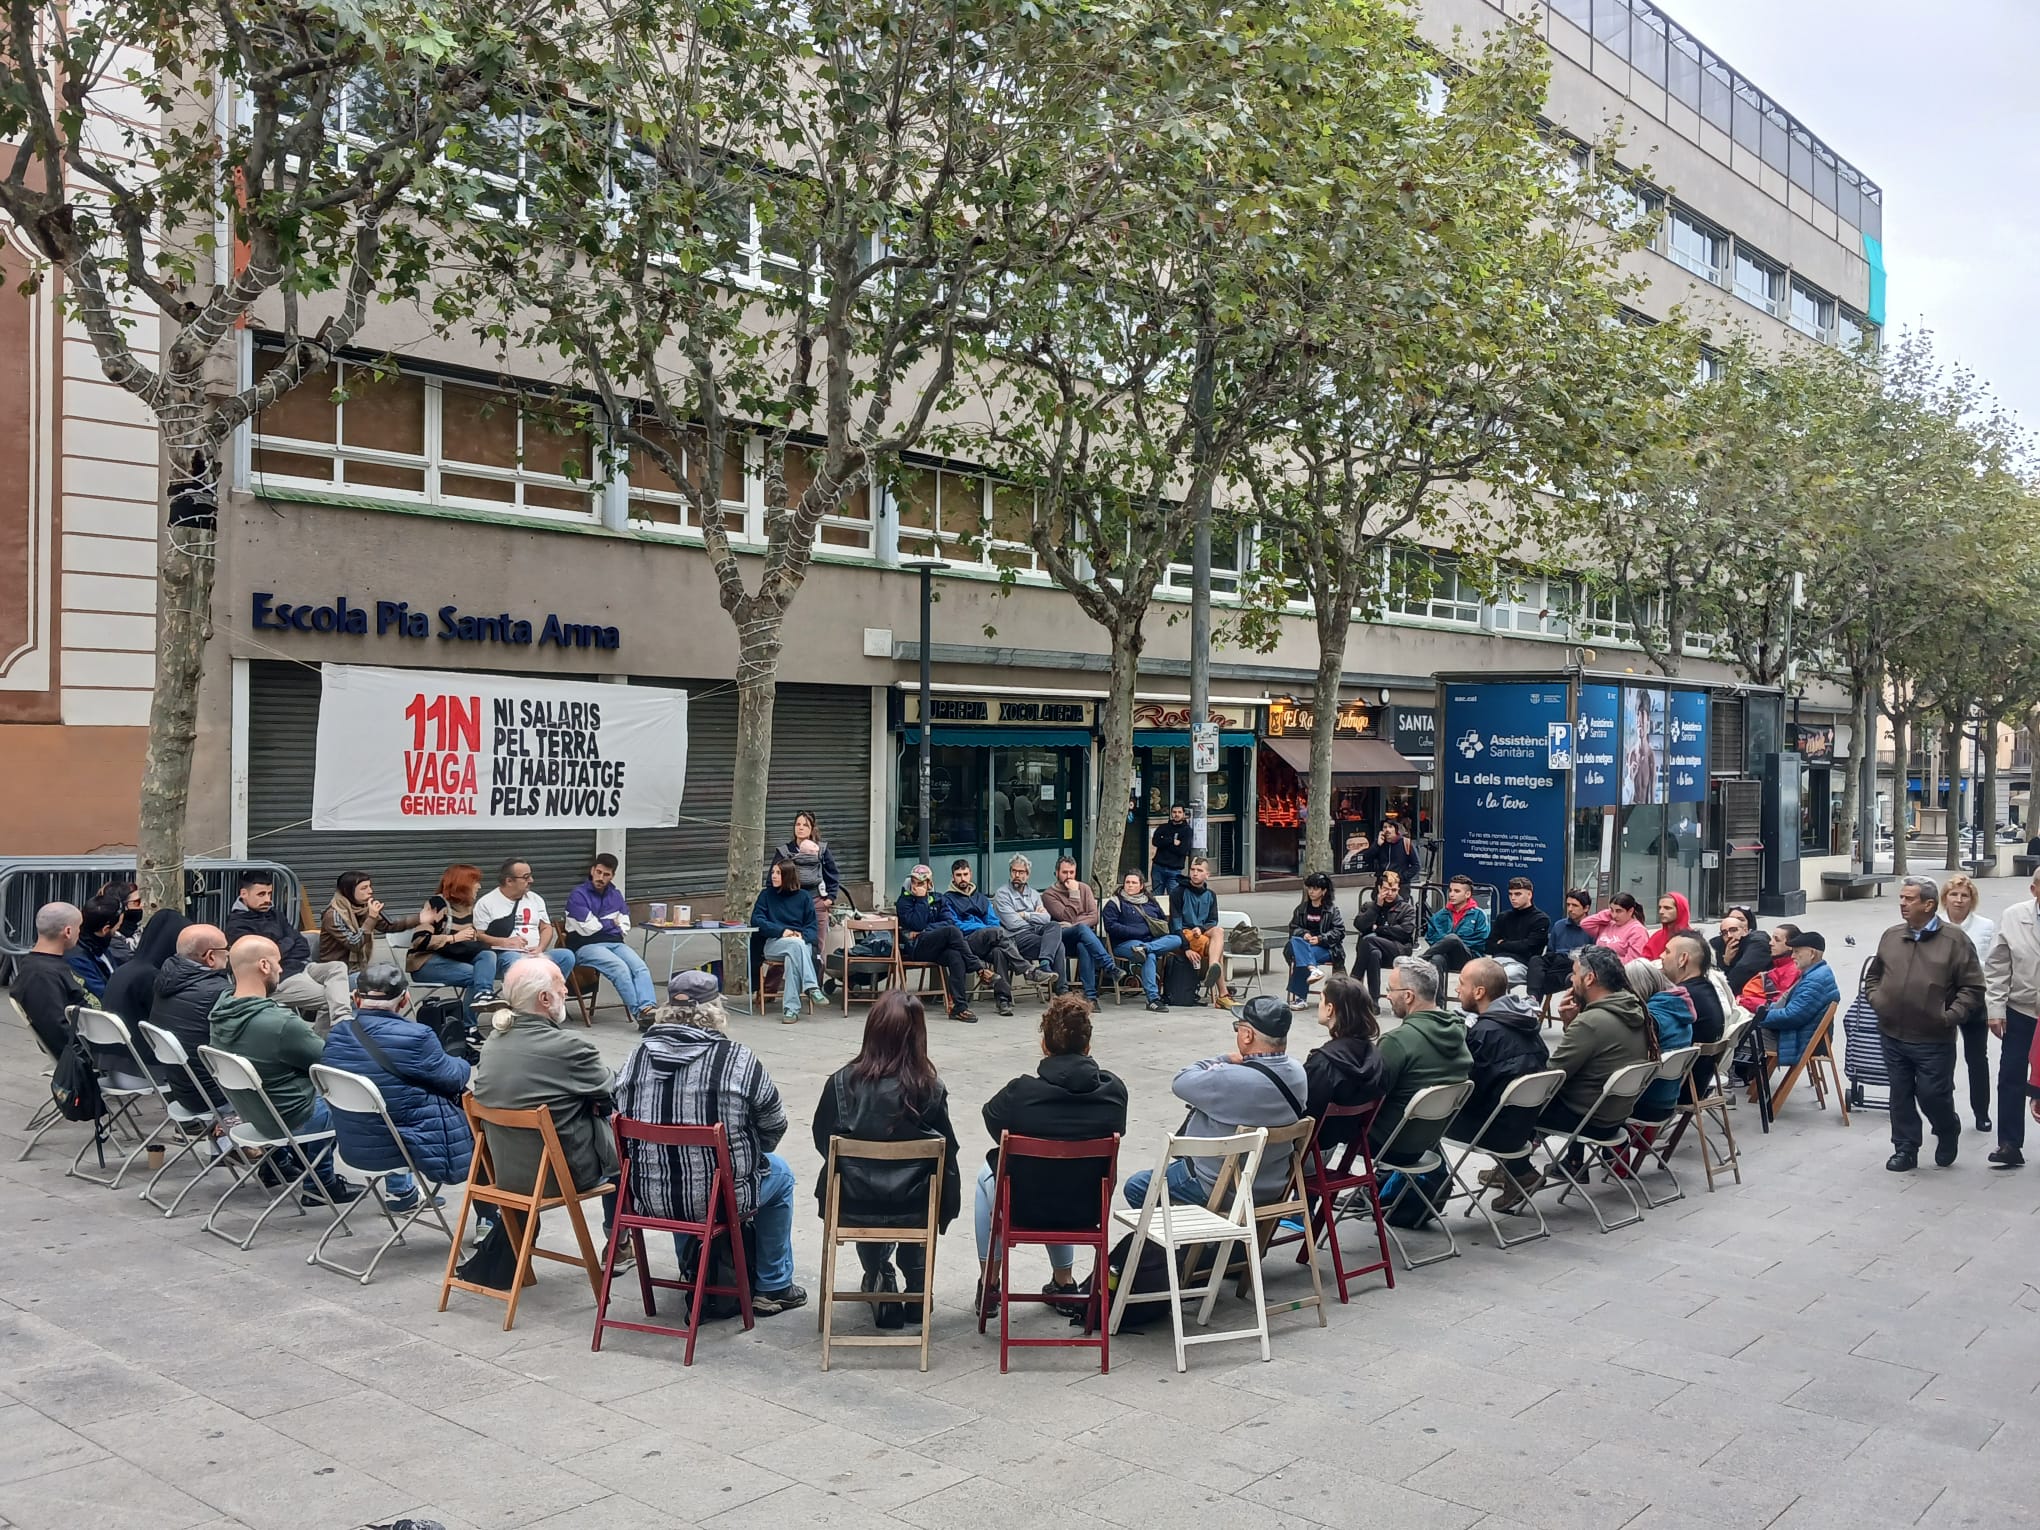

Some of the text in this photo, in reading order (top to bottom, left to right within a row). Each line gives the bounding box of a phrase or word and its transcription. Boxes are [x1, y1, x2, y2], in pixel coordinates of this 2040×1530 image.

[252, 592, 620, 649] Escola Pia Santa Anna
[405, 693, 480, 752] 11N
[493, 698, 600, 730] NI SALARIS
[1284, 708, 1299, 728] El
[1336, 710, 1369, 732] Jabugo
[1399, 714, 1435, 731] SANTA
[493, 727, 599, 760] PEL TERRA
[1489, 734, 1549, 746] Assistènci
[1555, 726, 1567, 746] P
[1489, 746, 1535, 758] Sanitària
[404, 750, 478, 794] VAGA
[492, 757, 625, 788] NI HABITATGE
[1454, 772, 1553, 789] La dels metges
[400, 795, 477, 816] GENERAL
[490, 787, 540, 816] PELS
[1477, 792, 1529, 809] i la teva
